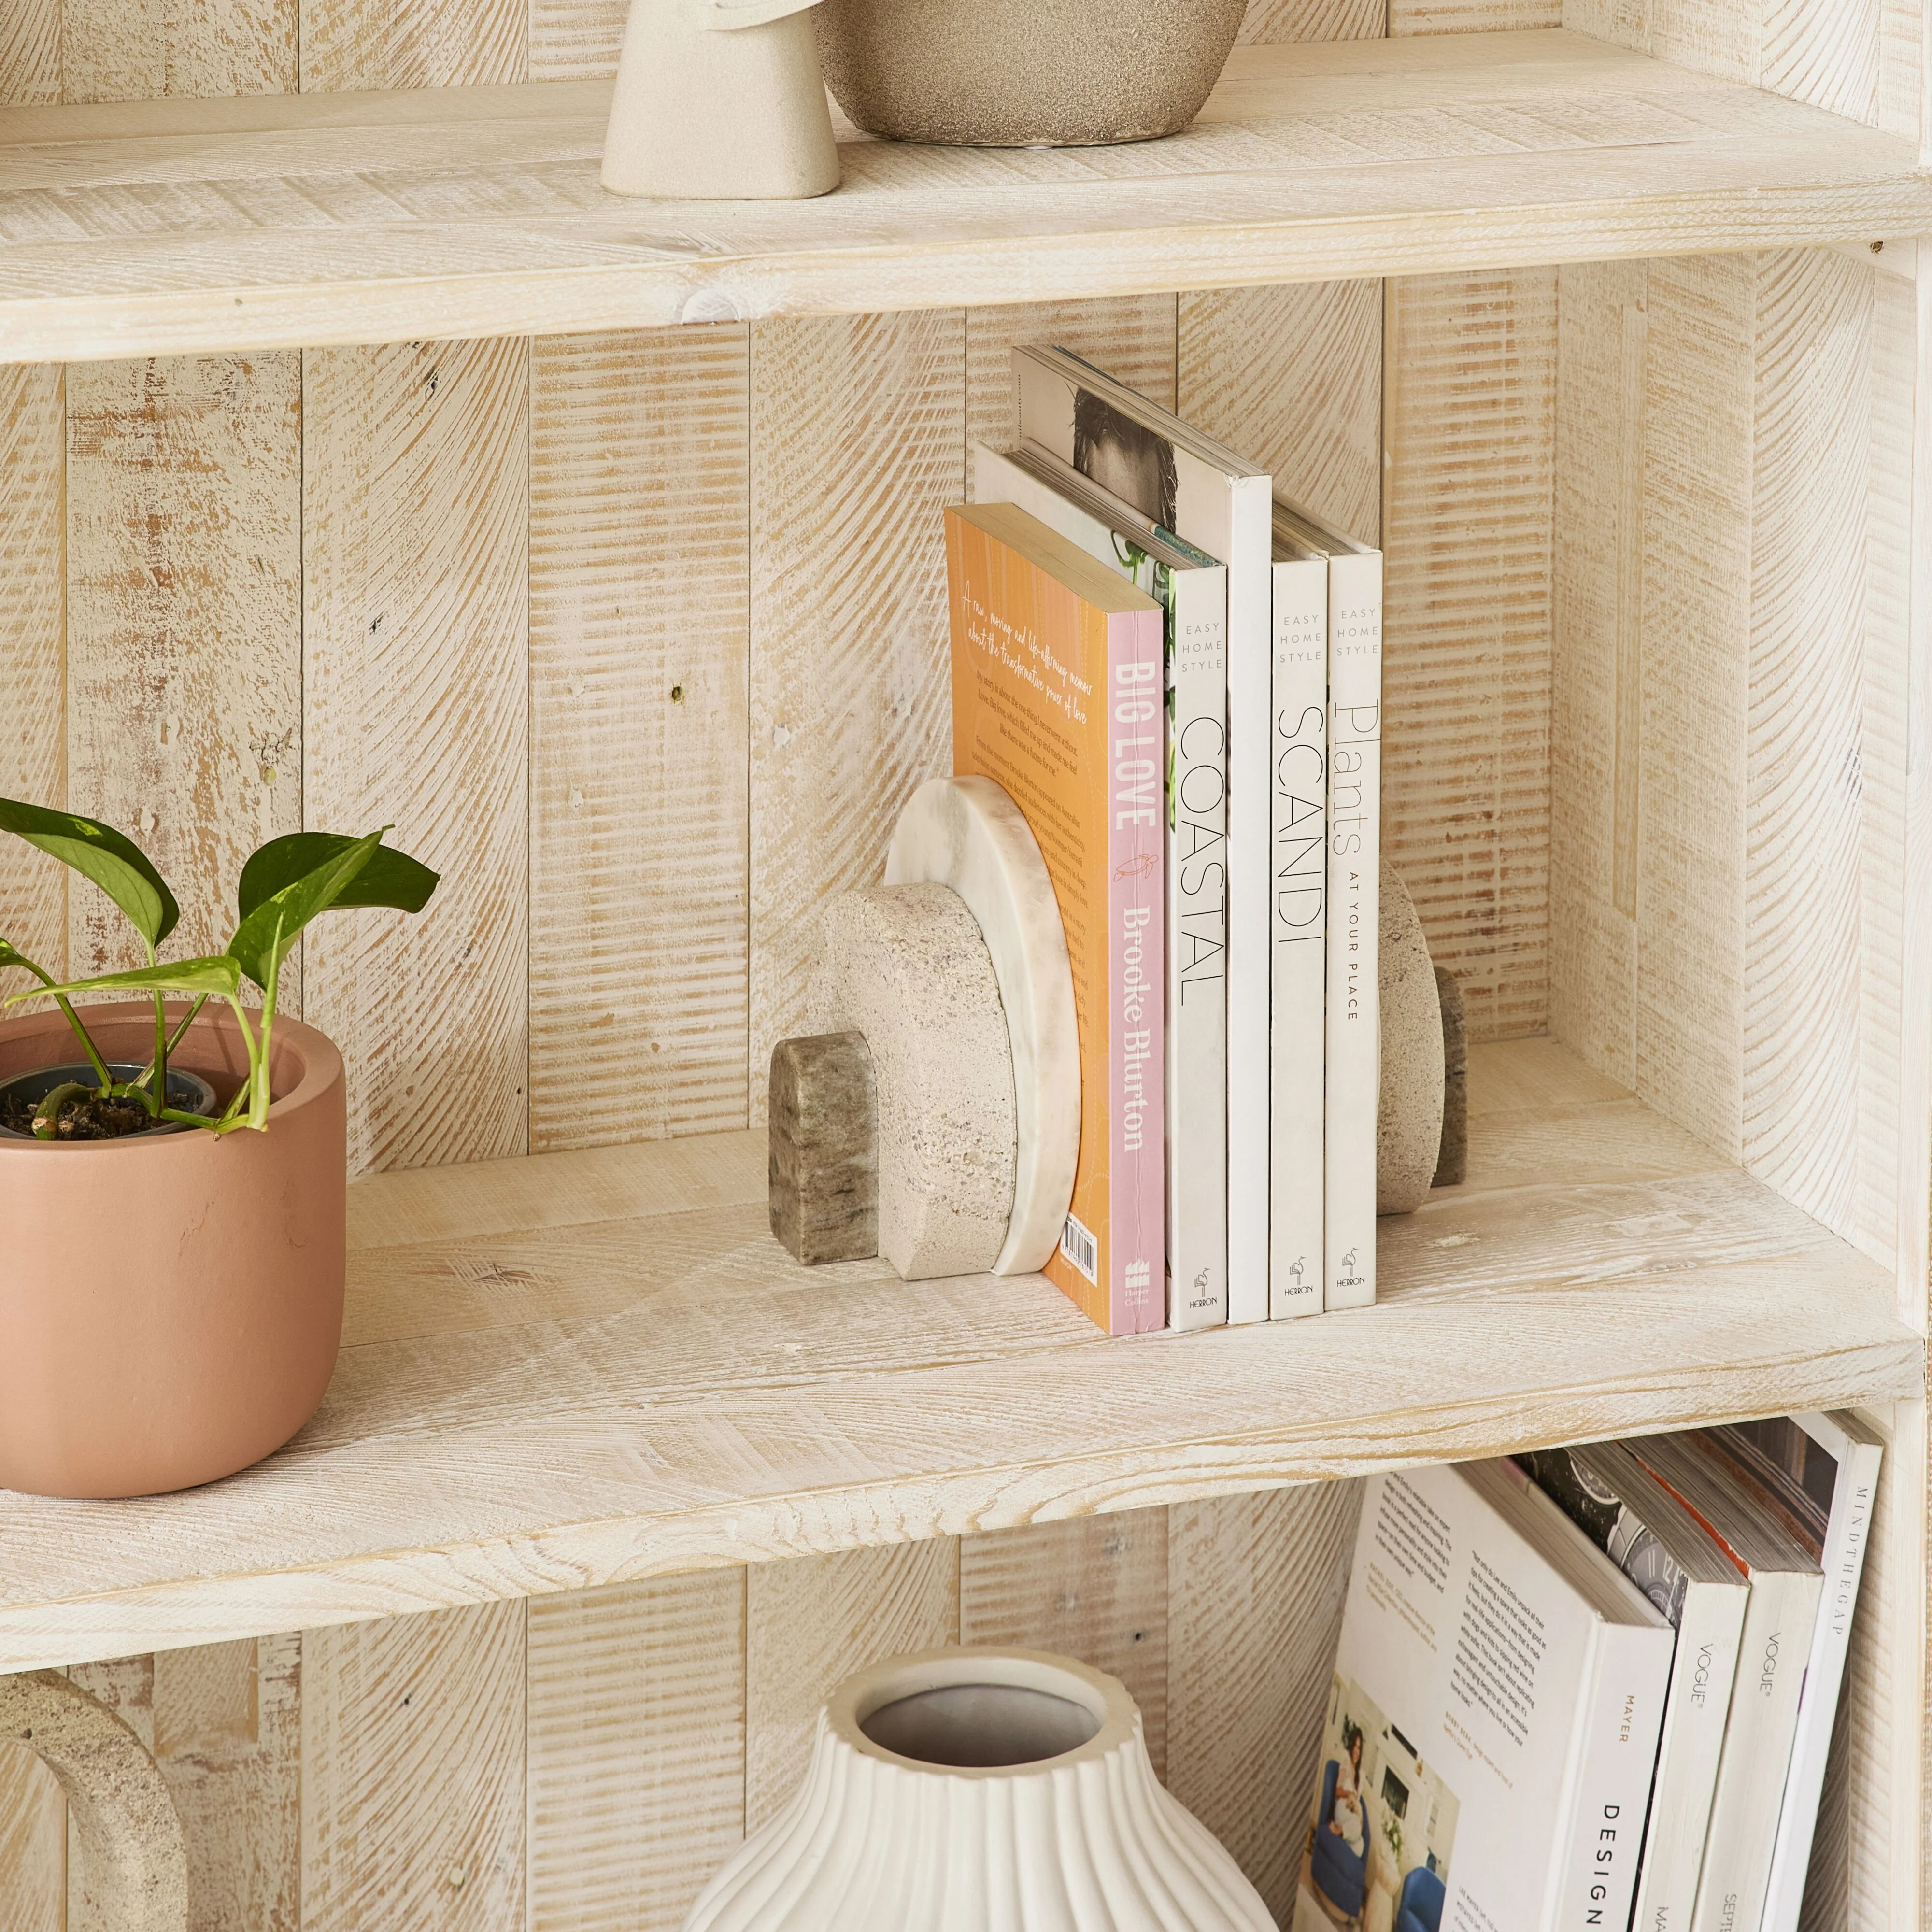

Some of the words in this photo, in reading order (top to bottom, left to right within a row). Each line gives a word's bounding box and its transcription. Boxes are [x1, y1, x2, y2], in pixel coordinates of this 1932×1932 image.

[1284, 614, 1319, 626] EASY
[1341, 608, 1376, 620] EASY
[1186, 622, 1220, 635] EASY
[1337, 626, 1378, 638] HOME
[962, 580, 971, 617] A
[973, 600, 987, 621] raw,
[990, 613, 1012, 644] moving
[1014, 626, 1026, 646] and
[1029, 630, 1067, 687] life-affirming
[1070, 672, 1092, 695] memoir
[1280, 633, 1322, 645] HOME
[1182, 640, 1222, 654] HOME
[1336, 644, 1378, 656] STYLE
[1182, 659, 1222, 672] STYLE
[1279, 651, 1322, 663] STYLE
[968, 622, 986, 650] about
[987, 632, 999, 657] the
[1000, 641, 1044, 691] transformative
[1046, 685, 1062, 705] power
[1065, 694, 1071, 719] of
[1073, 696, 1086, 724] love
[1114, 661, 1156, 724] BIG
[1115, 736, 1156, 830] LOVE
[1333, 699, 1381, 856] Plants
[1278, 706, 1324, 942] SCANDI
[1181, 717, 1224, 1006] COASTAL
[1350, 871, 1359, 892] AT
[1348, 902, 1359, 952] YOUR
[1123, 905, 1151, 1023] Brooke
[1347, 963, 1358, 1021] PLACE
[1123, 1028, 1151, 1153] Blurton
[1337, 1277, 1365, 1287] HERRON
[1125, 1289, 1149, 1298] Harper
[1284, 1286, 1313, 1296] HERRON
[1125, 1297, 1149, 1307] Collins
[1190, 1297, 1217, 1309] HERRON
[1619, 1694, 1634, 1742] MAYER
[1586, 1804, 1620, 1924] DESIGN
